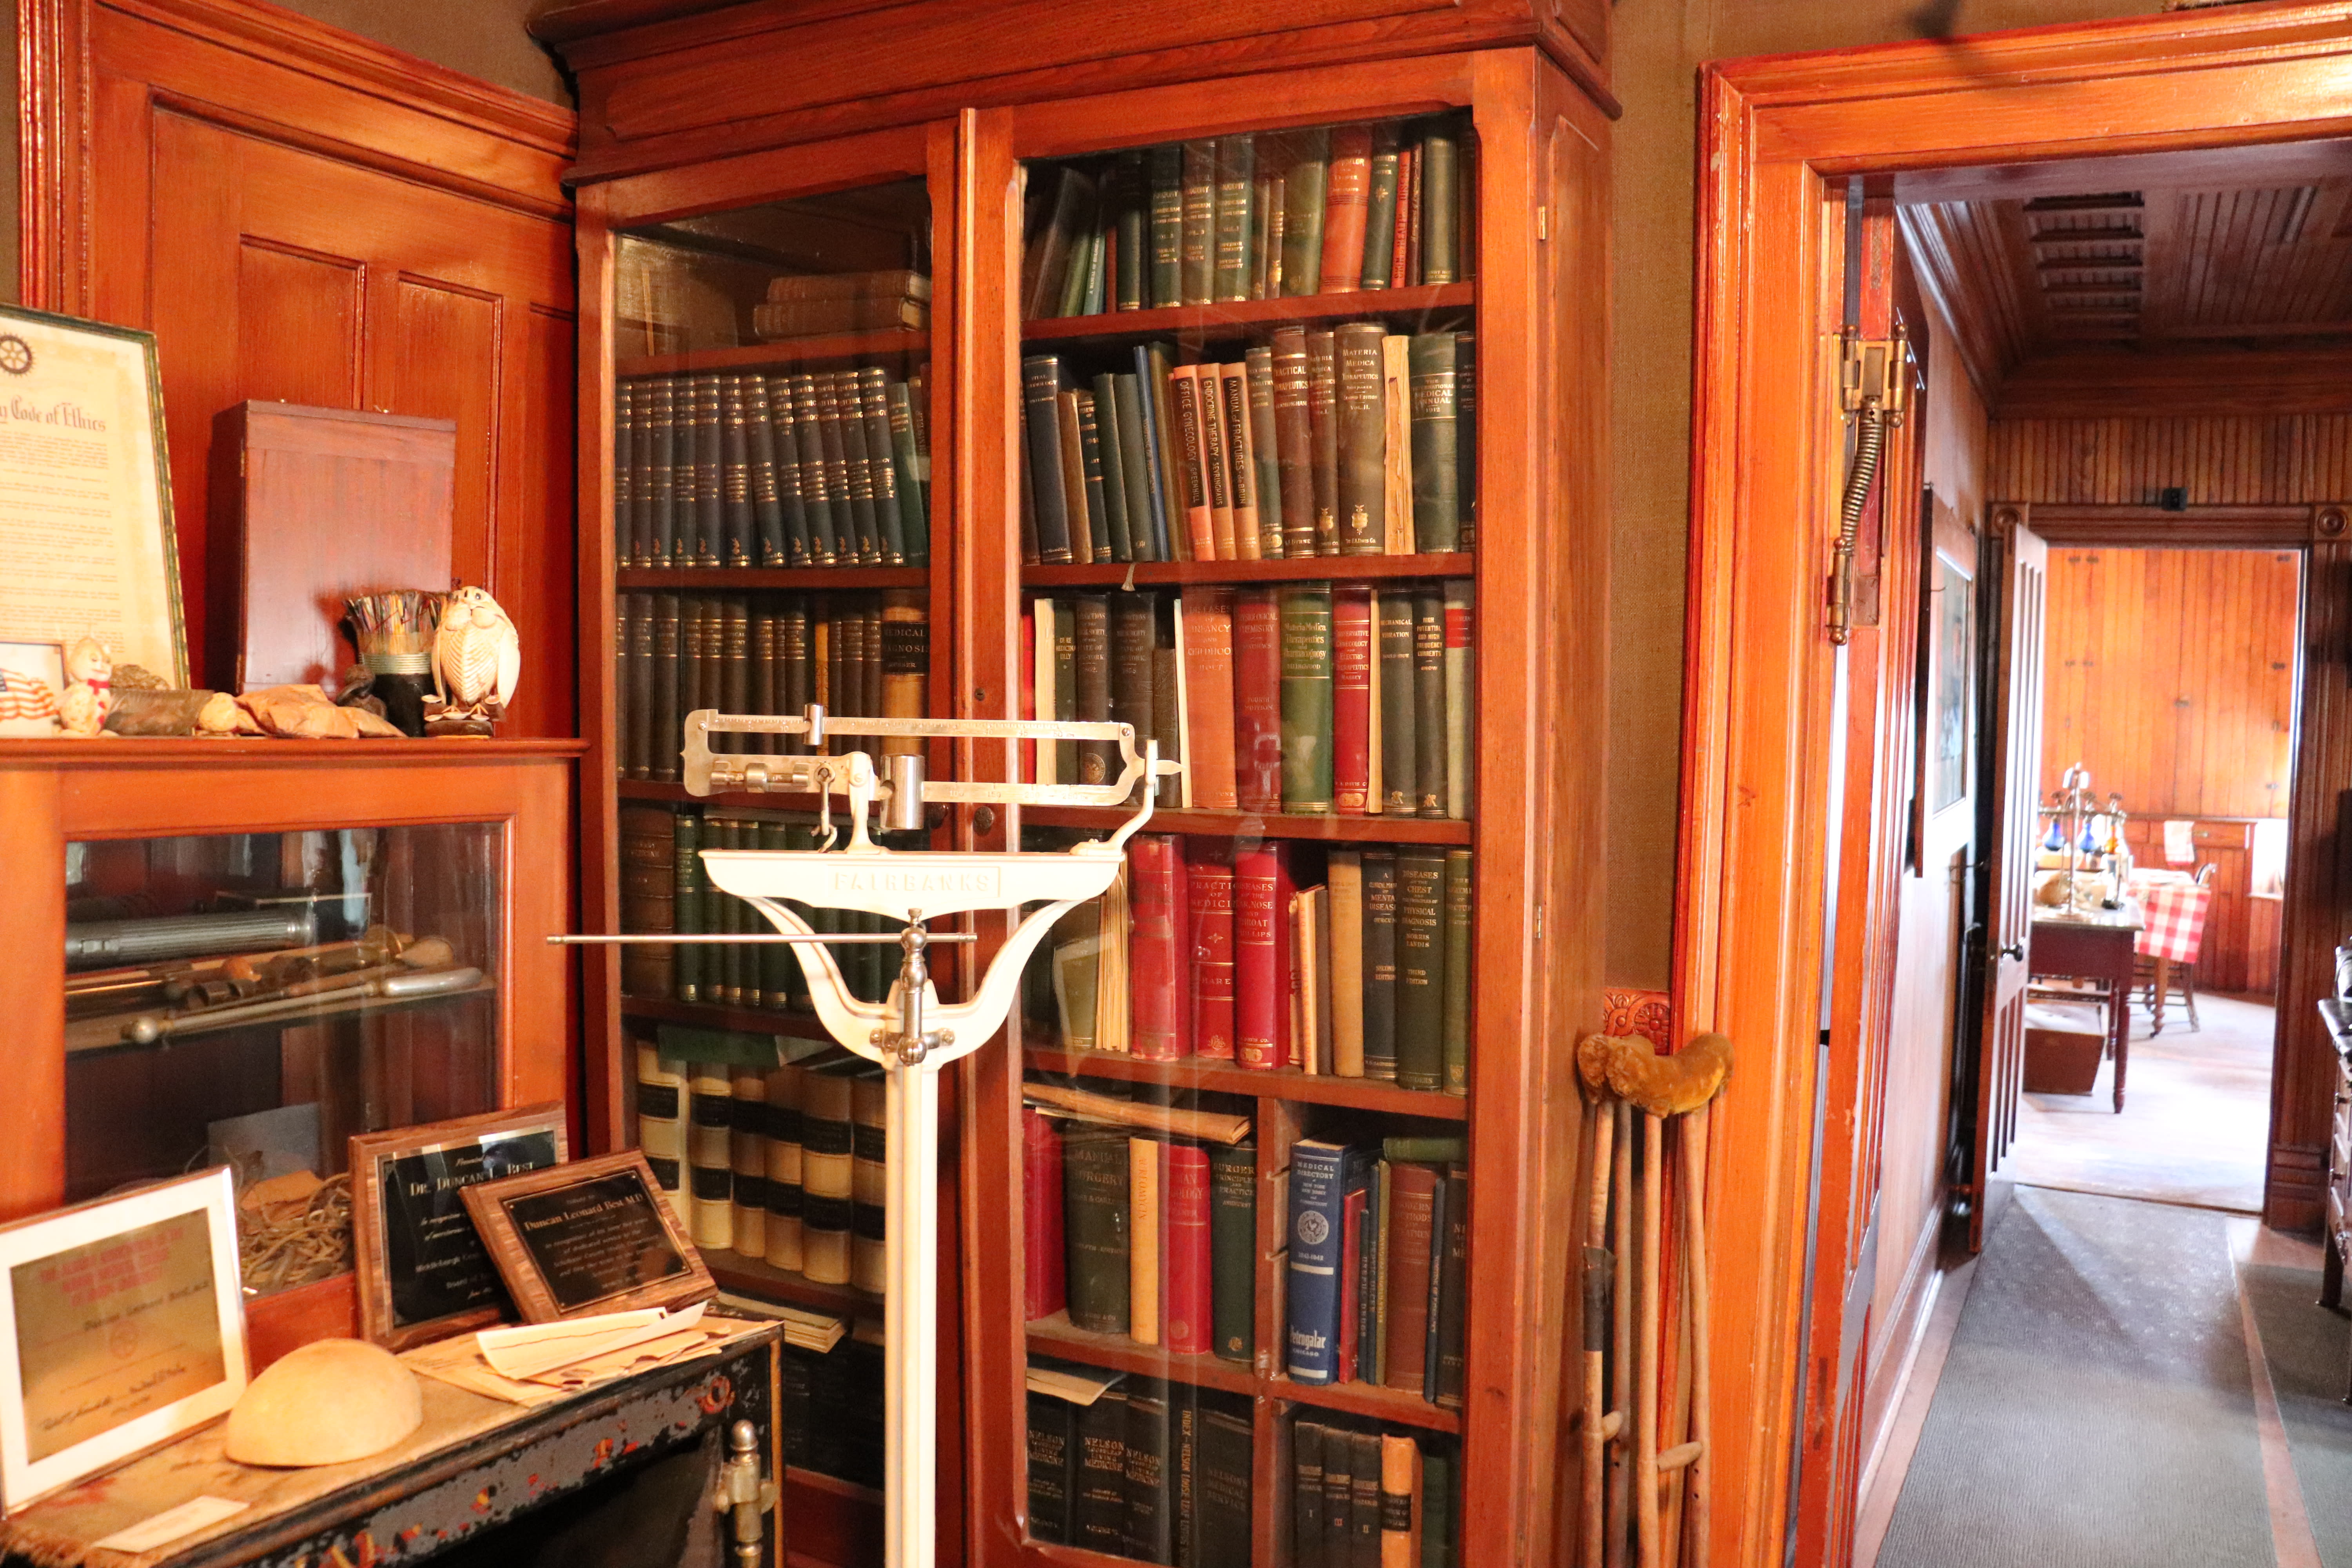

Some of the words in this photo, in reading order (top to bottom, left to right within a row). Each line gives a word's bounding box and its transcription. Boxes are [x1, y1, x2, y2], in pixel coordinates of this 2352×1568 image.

[1275, 366, 1306, 376] RACTICAL
[1180, 381, 1191, 408] OFFICE
[1203, 380, 1216, 421] ENDOCRINE
[1229, 380, 1240, 414] MANUAL
[11, 394, 42, 422] Code
[46, 404, 59, 425] of
[61, 401, 106, 432] Ethics
[1183, 411, 1197, 461] GYNECOLOGY
[1207, 422, 1220, 457] THERAPY
[1233, 423, 1244, 470] FRACTURES
[1190, 467, 1200, 503] GREENHILL
[1212, 462, 1223, 505] SEVRINGHAUS
[884, 628, 926, 637] MEDICAL
[1192, 624, 1231, 633] INFANCY
[1285, 633, 1325, 645] Therapeutics
[1188, 647, 1231, 656] CHILDHOO
[1284, 648, 1327, 660] Pharmacognosy
[835, 872, 990, 891] FAIRBANKS
[1403, 870, 1439, 880] DISEASES
[1407, 886, 1432, 894] CHEST
[1252, 901, 1273, 909] NOSE
[1404, 907, 1436, 916] PHYSICAL
[1402, 917, 1437, 926] DIAGNOSIS
[1297, 1161, 1334, 1172] MEDICAL
[437, 1172, 485, 1191] DUNCAN
[507, 1161, 533, 1175] BEST
[1297, 1169, 1334, 1180] DIRECTORY
[524, 1215, 563, 1231] Duncan
[563, 1203, 604, 1221] Leonard
[604, 1199, 624, 1210] Best
[1293, 1348, 1319, 1357] CHICAGO
[1182, 1410, 1192, 1437] INDEX
[1085, 1436, 1125, 1451] NELSON
[1126, 1447, 1161, 1466] NELSON
[1181, 1443, 1191, 1472] NELSON
[1085, 1457, 1123, 1472] MEDICINE
